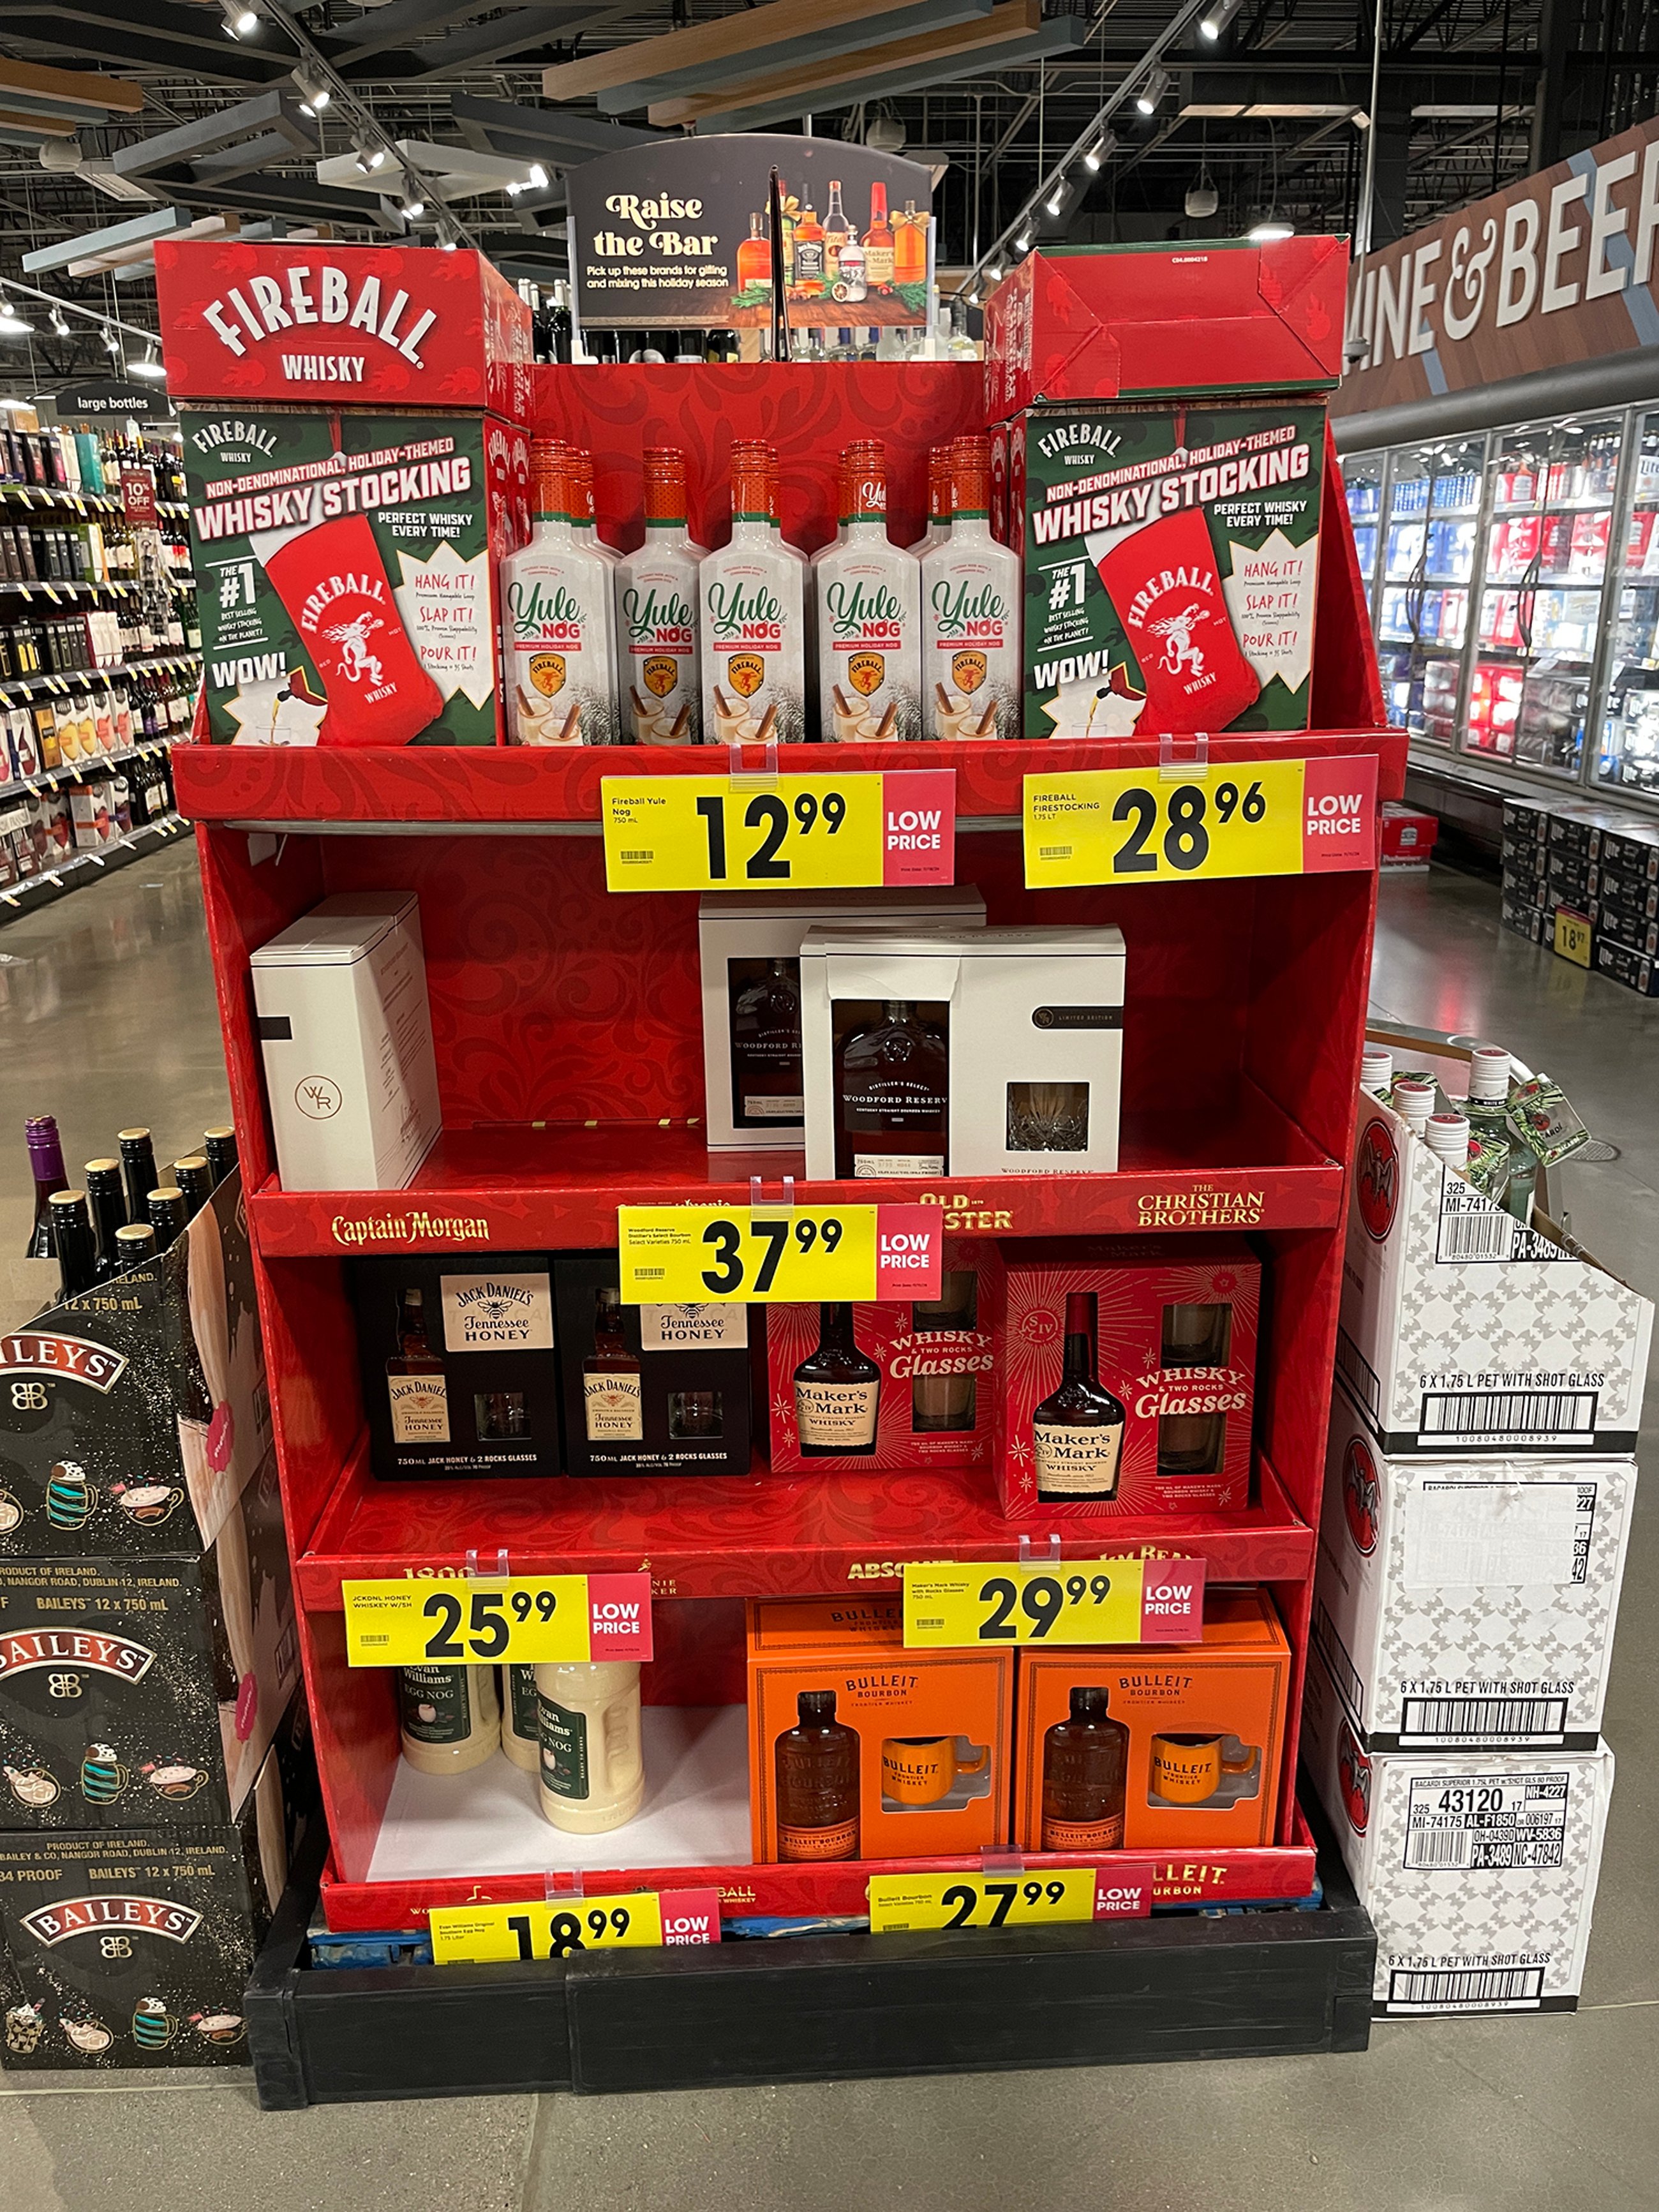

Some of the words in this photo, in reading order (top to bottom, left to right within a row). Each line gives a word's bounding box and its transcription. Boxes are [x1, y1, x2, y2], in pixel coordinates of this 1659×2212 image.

[606, 192, 703, 230] Raise
[593, 231, 644, 257] the
[648, 231, 719, 257] Bar
[587, 265, 607, 277] Pick
[609, 268, 621, 279] up
[623, 265, 648, 277] these
[650, 265, 683, 277] brands
[684, 265, 697, 277] for
[699, 265, 727, 279] gifting
[1443, 218, 1498, 340] &
[587, 277, 607, 288] and
[609, 277, 639, 290] mixing
[641, 277, 657, 288] this
[658, 277, 694, 291] holiday
[695, 278, 729, 289] season
[203, 266, 437, 365] FIREBALL
[281, 355, 365, 382] WHISKY
[78, 397, 107, 411] large
[108, 397, 149, 409] bottles
[192, 420, 278, 456] FIREBALL
[1038, 423, 1122, 458] FIREBALL
[221, 452, 251, 463] WHISKY
[205, 460, 346, 500] NON-DENOMINATIONAL,
[348, 437, 454, 470] HOLIDAY-THEMED
[126, 483, 150, 496] 10%
[1032, 484, 1154, 545] WHISKY
[1161, 444, 1310, 512] STOCKING
[128, 496, 150, 506] OFF
[193, 483, 314, 541] WHISKY
[323, 456, 472, 518] STOCKING
[378, 512, 426, 525] PERFECT
[429, 513, 473, 525] WHISKY
[392, 525, 428, 537] EVERY
[431, 527, 461, 539] TIME!
[219, 566, 237, 578] THE
[220, 562, 256, 608] #1
[415, 574, 450, 590] HANG
[455, 574, 475, 590] IT!
[302, 573, 385, 633] FIREBALL
[508, 581, 581, 634] Yule
[826, 581, 902, 634] Yule
[221, 611, 234, 621] BEST
[235, 608, 257, 619] SELLING
[420, 606, 449, 622] SLAP
[453, 607, 473, 622] IT!
[218, 622, 236, 632] WHISKY
[237, 617, 262, 629] STOCKING
[227, 632, 239, 641] THE
[420, 646, 454, 661] POUR
[458, 646, 477, 661] IT!
[212, 652, 286, 689] WOW!
[1034, 649, 1109, 690] WOW!
[364, 682, 398, 704] WHISKY
[612, 796, 646, 805] Fireball
[647, 796, 666, 805] Yule
[1033, 793, 1077, 802] FIREBALL
[613, 808, 631, 818] Nog
[1033, 802, 1100, 812] FIRESTOCKING
[888, 811, 942, 831] LOW
[887, 833, 941, 851] PRICE
[842, 1095, 902, 1103] WOODFORD
[905, 1096, 948, 1104] RESERV
[1193, 1184, 1214, 1193] THE
[1446, 1182, 1466, 1194] 325
[1137, 1192, 1265, 1212] CHRISTIAN
[1138, 1208, 1262, 1226] BROTHERS
[332, 1213, 407, 1246] Captain
[405, 1211, 490, 1244] Morgan
[456, 1287, 483, 1308] JACK
[486, 1282, 535, 1306] DANIEL'S
[464, 1315, 530, 1330] Tennessee
[465, 1330, 531, 1341] HONEY
[1136, 1367, 1246, 1389] WHISKY
[1419, 1375, 1426, 1389] 6
[1429, 1375, 1437, 1387] X
[1441, 1374, 1464, 1387] 1.75
[1467, 1374, 1474, 1387] L
[1477, 1374, 1499, 1387] PET
[1502, 1373, 1532, 1387] WITH
[1535, 1373, 1566, 1387] SHOT
[1568, 1373, 1605, 1387] GLASS
[1135, 1392, 1247, 1419] Glasses
[1034, 1430, 1111, 1445] Maker's
[1053, 1447, 1108, 1459] Mark
[403, 1667, 452, 1684] Williams
[845, 1675, 919, 1691] BULLEIT
[404, 1685, 424, 1698] EGG
[426, 1689, 454, 1700] NOG
[858, 1689, 907, 1698] BOURBON
[883, 1755, 939, 1775] BULLEIT
[1439, 1788, 1503, 1812] 43120
[1526, 1786, 1566, 1799] NH-4227
[1412, 1816, 1463, 1829] MI-74175
[1466, 1814, 1515, 1828] AL-F1850
[1525, 1814, 1554, 1826] 006197
[1516, 1828, 1562, 1841] WV-5836
[47, 1841, 91, 1850] PRODUCT
[93, 1841, 105, 1849] OF
[107, 1839, 150, 1848] IRELAND.
[1473, 1845, 1512, 1867] PA-3489
[1514, 1842, 1561, 1865] NC-47842
[17, 1869, 63, 1881] PROOF
[89, 1866, 137, 1879] BAILEYS
[145, 1866, 160, 1878] 12
[162, 1869, 170, 1878] x
[174, 1865, 194, 1878] 750
[197, 1864, 216, 1876] mL
[36, 1900, 186, 1937] BAILEYS
